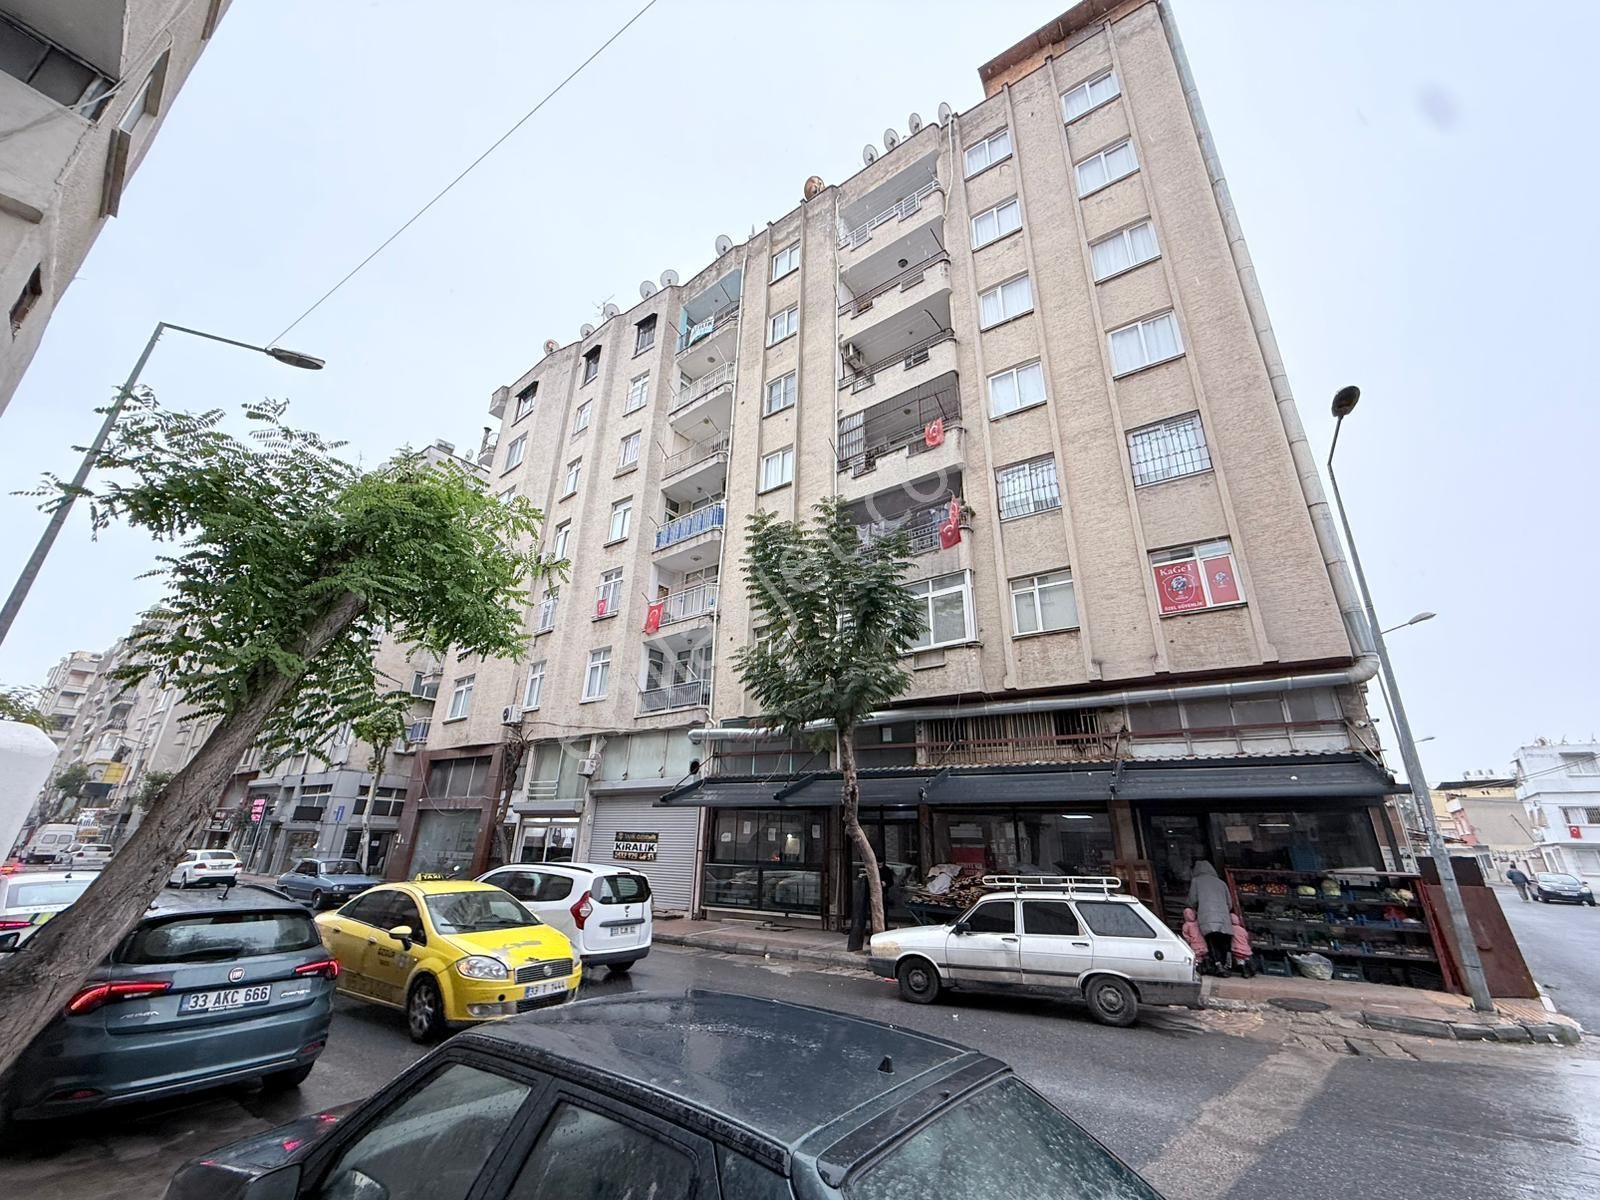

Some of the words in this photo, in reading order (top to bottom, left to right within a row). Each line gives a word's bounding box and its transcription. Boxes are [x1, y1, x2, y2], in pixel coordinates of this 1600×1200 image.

[1159, 563, 1193, 577] KaGeT
[189, 994, 208, 1009] 33
[213, 991, 239, 1006] AKC
[245, 987, 268, 1002] 666
